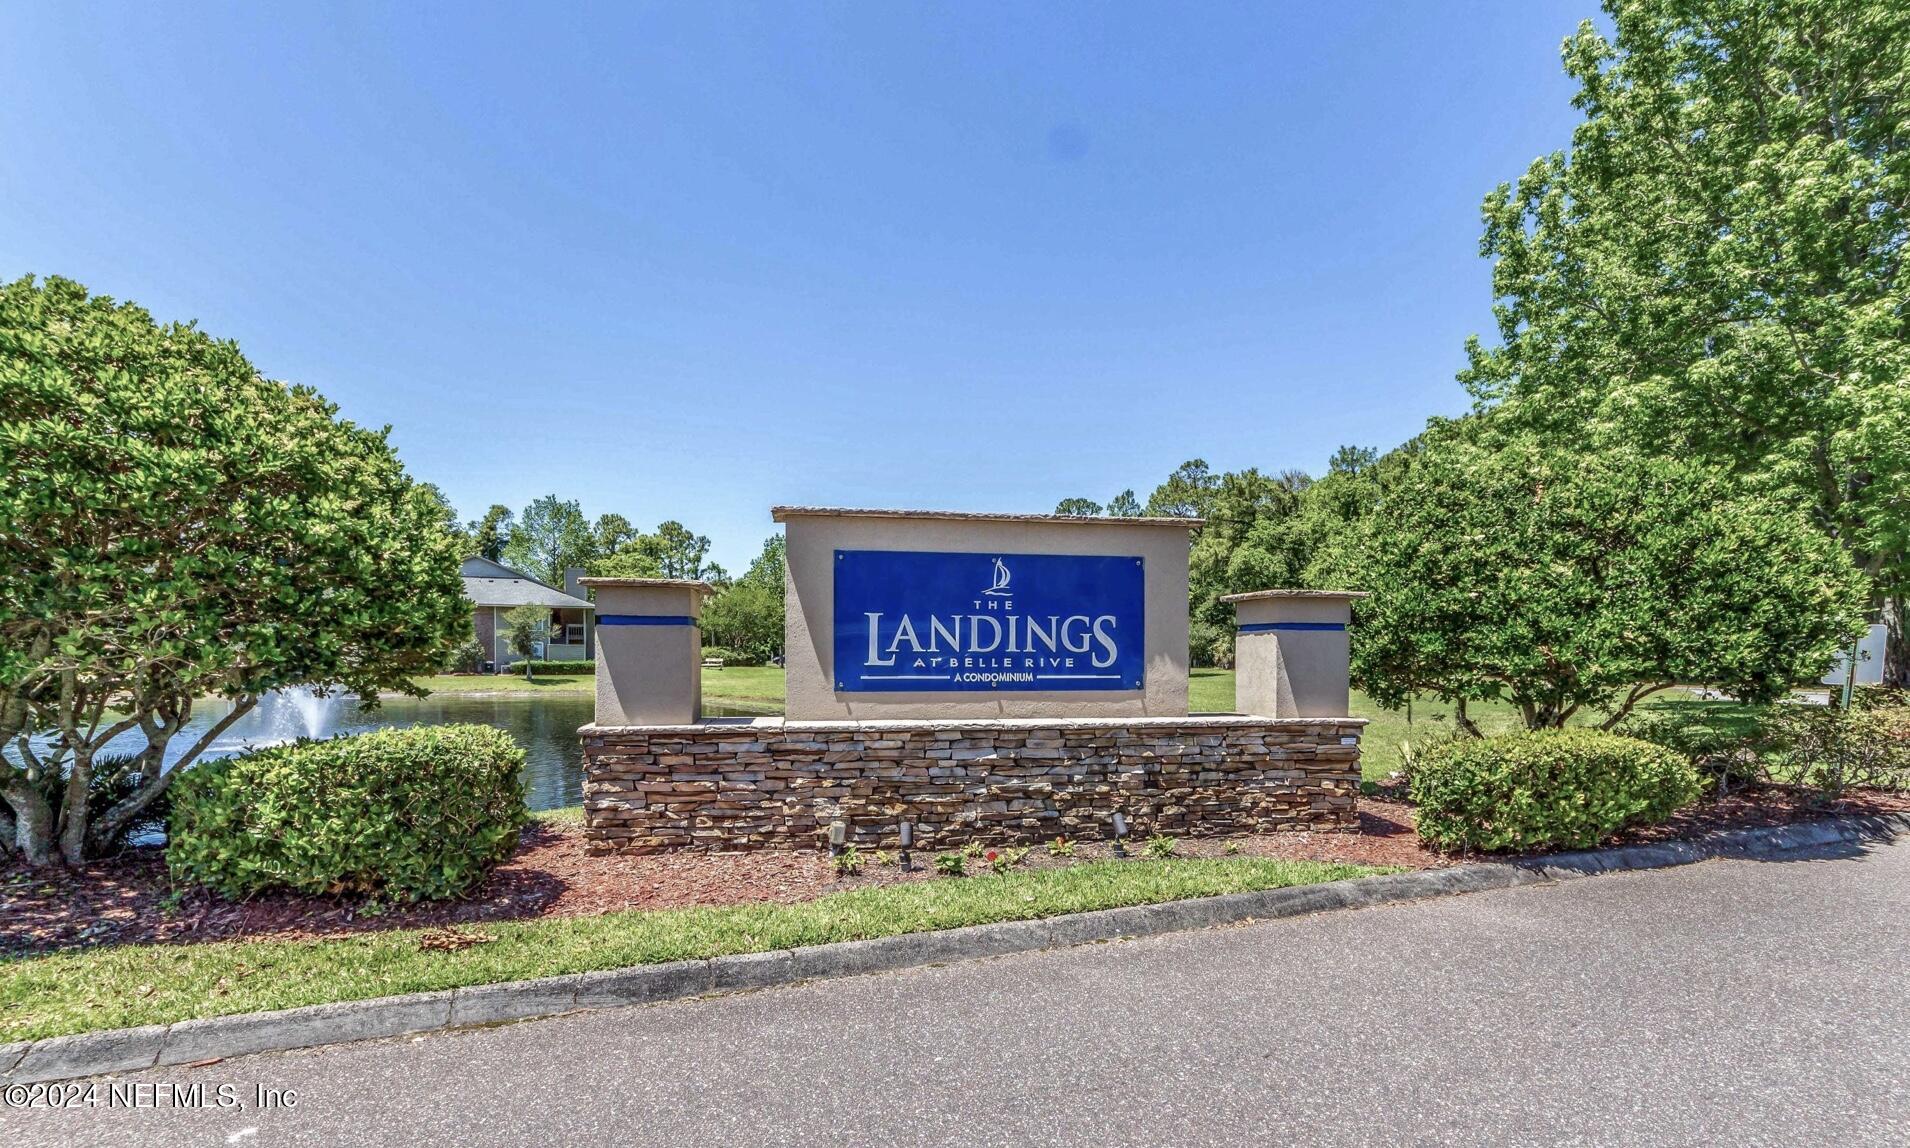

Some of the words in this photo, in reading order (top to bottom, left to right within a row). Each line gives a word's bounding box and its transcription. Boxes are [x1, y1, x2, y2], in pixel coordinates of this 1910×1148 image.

[974, 600, 1013, 610] THE
[863, 612, 1118, 668] LANDINGS
[913, 658, 940, 667] AT
[950, 658, 1012, 668] BELLE
[1025, 658, 1074, 668] RIVE
[954, 673, 962, 682] A
[963, 672, 1034, 682] CONDOMINIUM
